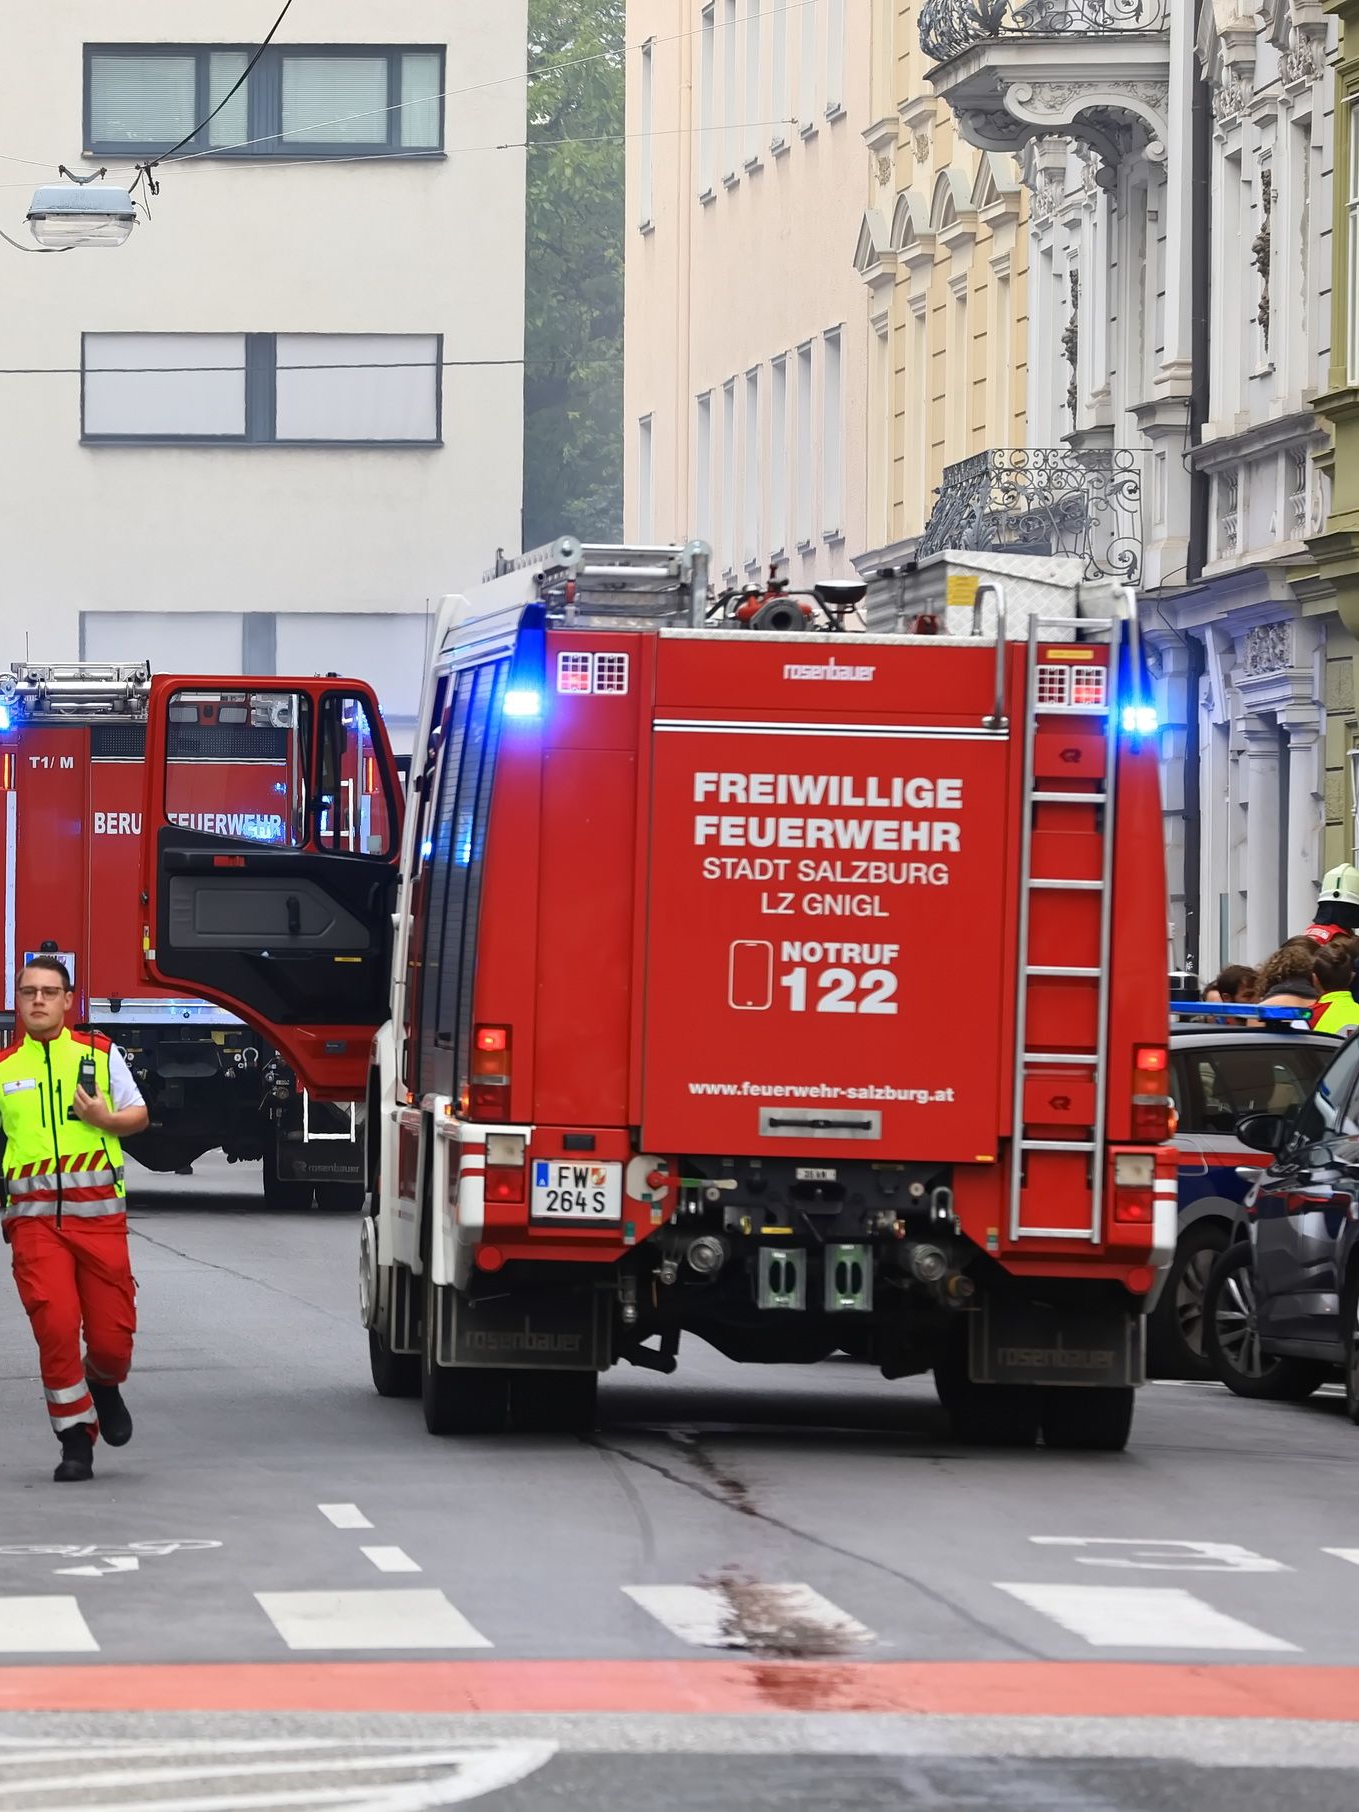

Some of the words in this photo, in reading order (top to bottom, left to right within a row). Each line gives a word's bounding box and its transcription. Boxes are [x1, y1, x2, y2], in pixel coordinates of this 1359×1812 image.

[783, 657, 876, 681] rosenbauer
[694, 772, 963, 809] FREIWILLIGE
[694, 815, 961, 852] FEUERWEHR
[702, 857, 791, 881] STADT
[798, 860, 949, 885] SALZBURG
[761, 892, 796, 914] LZ
[802, 893, 890, 917] GNIGL
[781, 941, 900, 965] NOTRUF
[780, 967, 899, 1014] 122
[688, 1081, 955, 1104] www.feuerwehr-salzburg.at
[558, 1167, 589, 1188] FW
[546, 1190, 587, 1213] 264
[592, 1191, 606, 1213] S
[465, 1314, 582, 1350] rosenbauer
